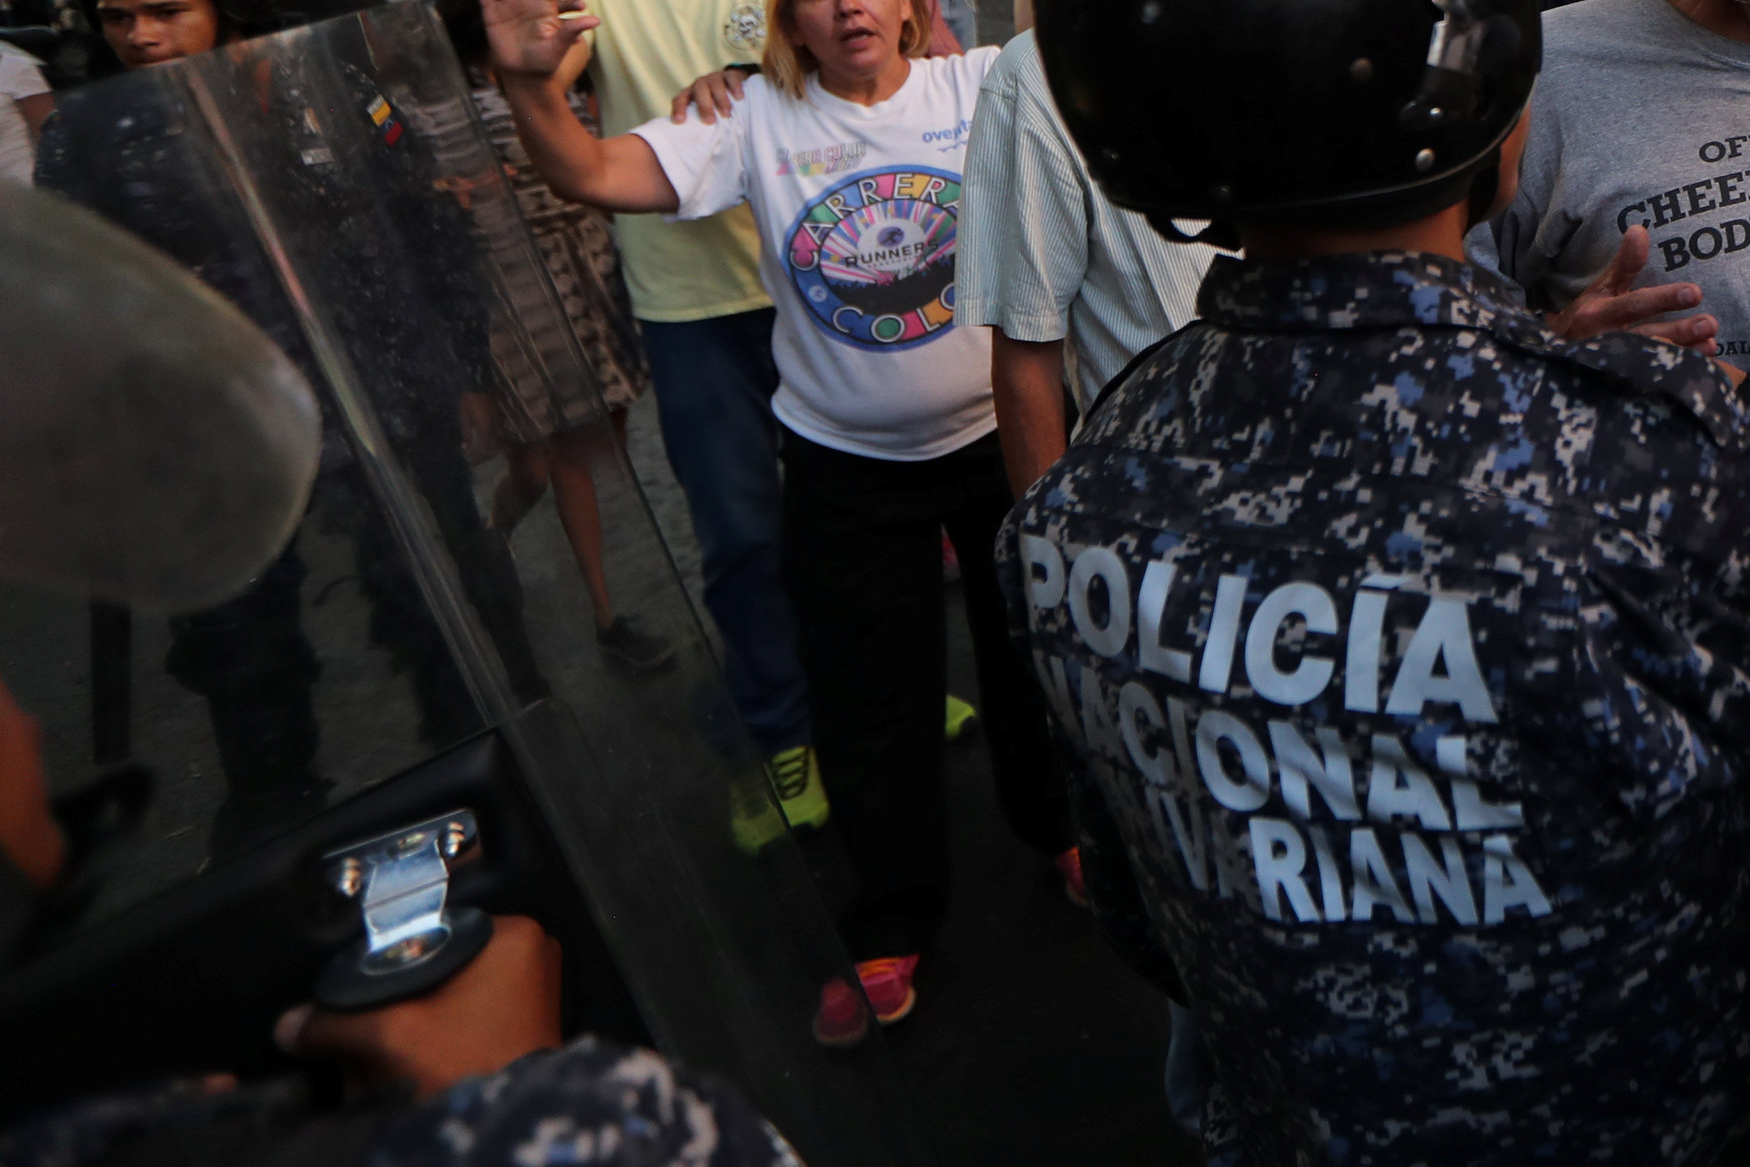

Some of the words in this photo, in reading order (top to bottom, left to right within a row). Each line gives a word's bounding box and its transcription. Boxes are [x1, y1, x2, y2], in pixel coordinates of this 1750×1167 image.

[845, 241, 939, 268] RUNNERS
[1019, 535, 1499, 723] POLICÍA
[1034, 648, 1524, 832] NACIONAL
